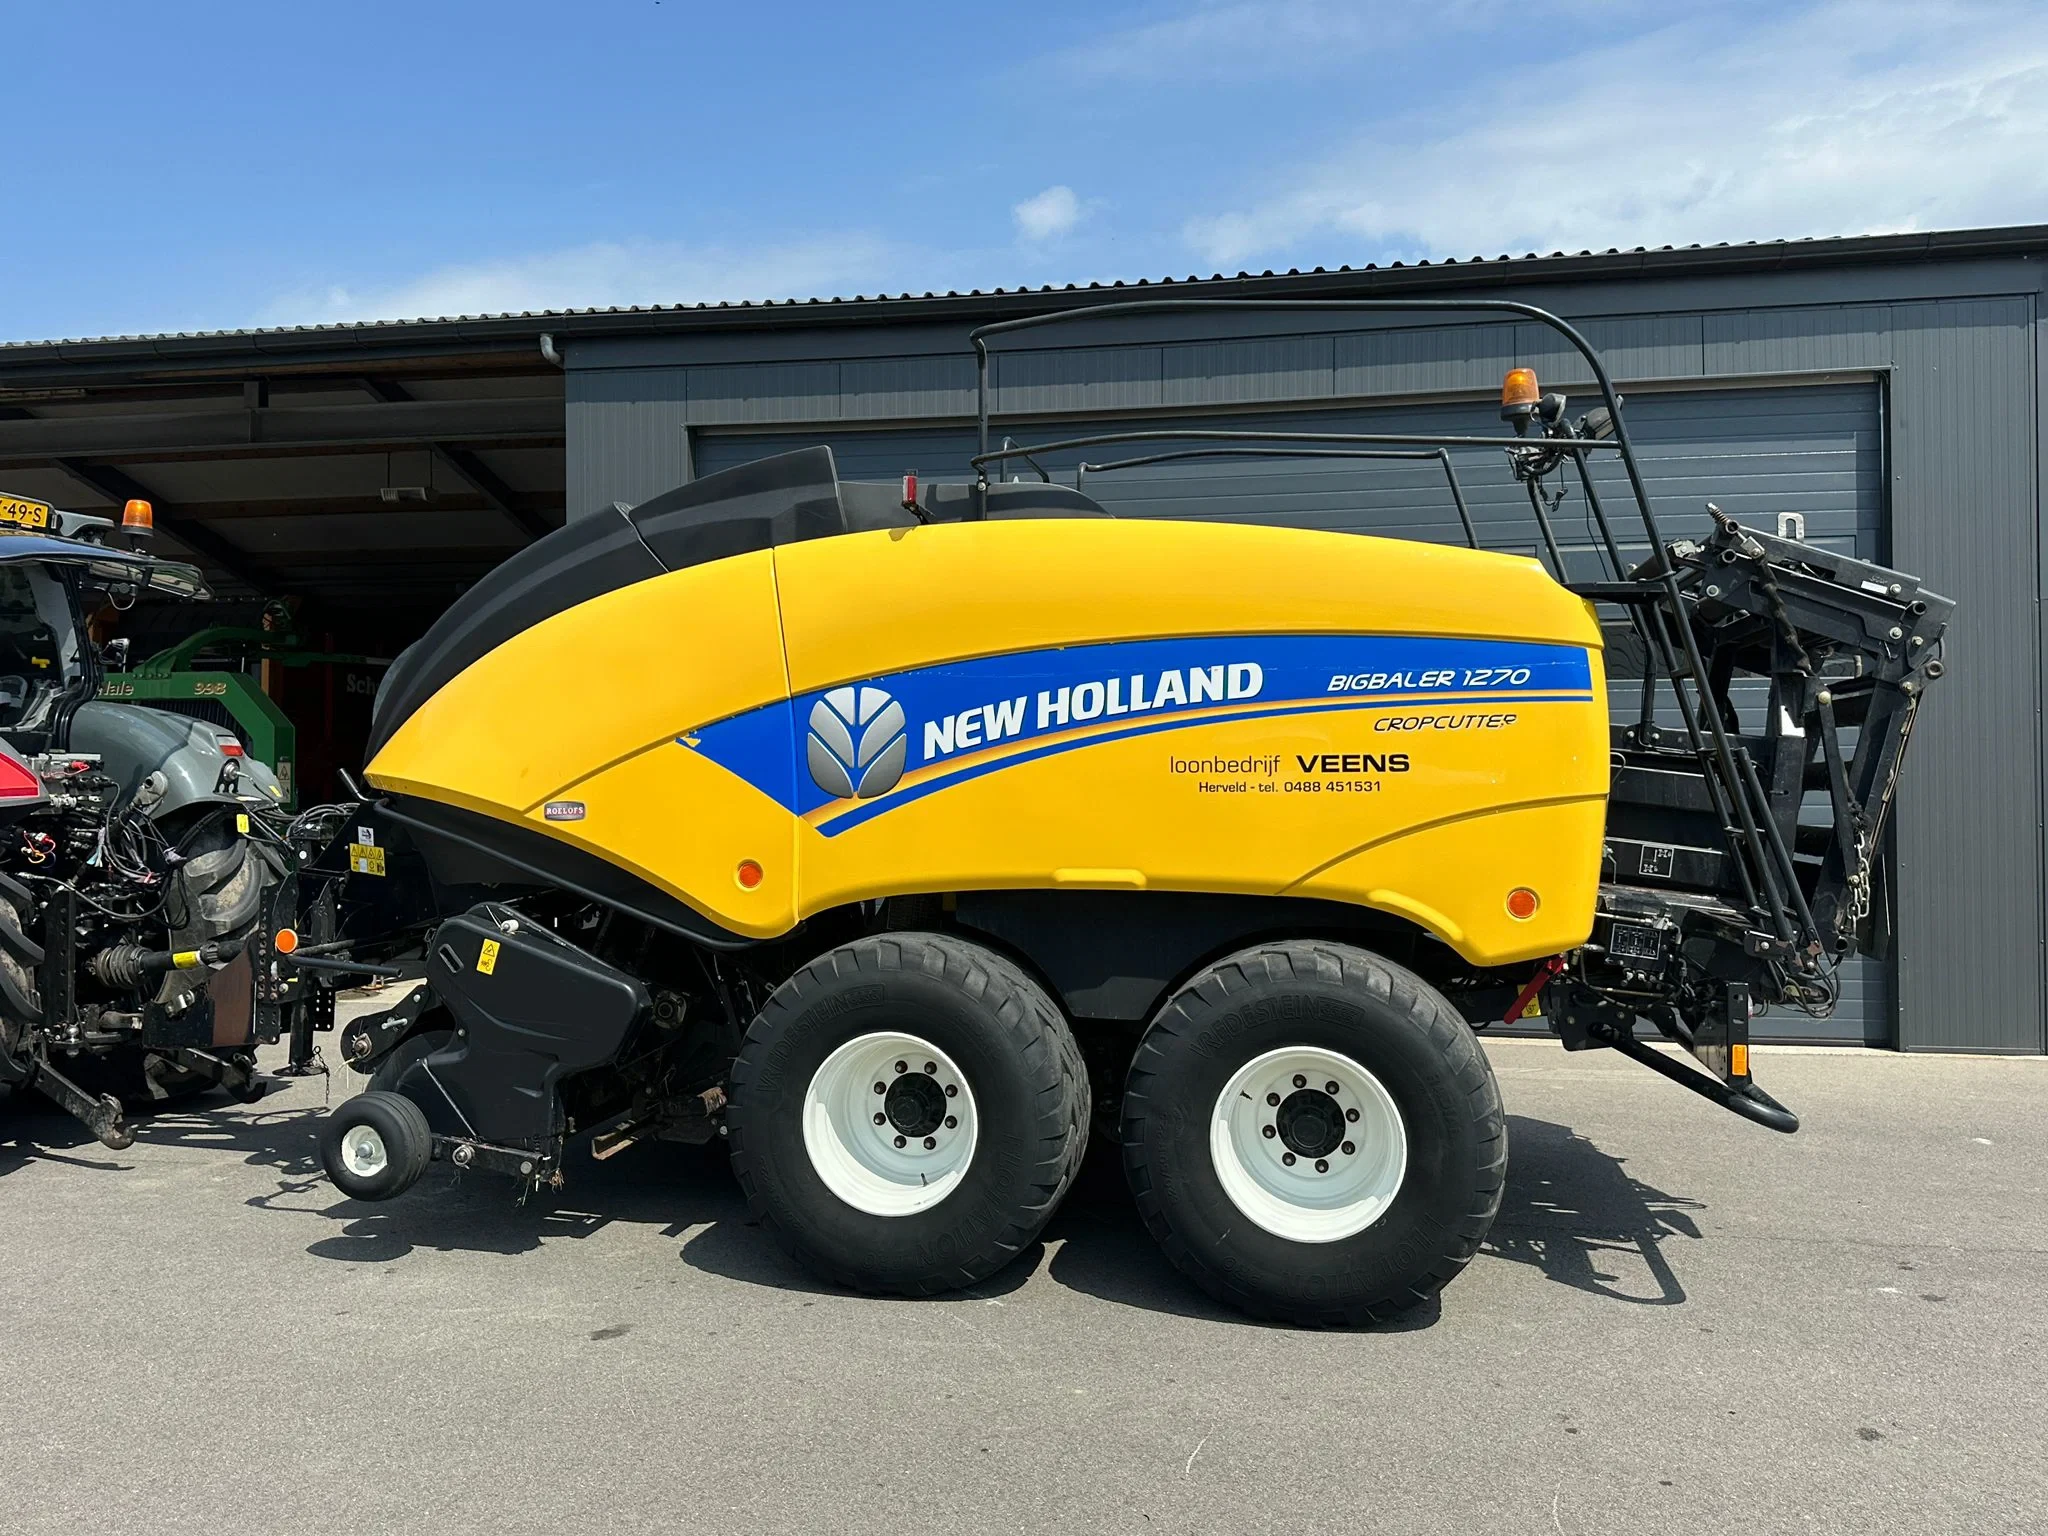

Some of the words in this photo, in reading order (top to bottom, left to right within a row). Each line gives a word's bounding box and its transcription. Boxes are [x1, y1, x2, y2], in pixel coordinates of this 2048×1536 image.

[0, 500, 42, 523] -49-S
[346, 673, 376, 695] Sch
[1327, 670, 1457, 693] BIGBALER
[1462, 668, 1531, 688] 1270
[923, 694, 1029, 761] NEW
[1036, 662, 1264, 729] HOLLAND
[1374, 714, 1517, 731] CROPCUTTER
[1169, 755, 1280, 777] loonbedrijf
[1296, 754, 1410, 773] VEENS
[1199, 781, 1247, 793] Herveld
[1258, 781, 1279, 793] tel.
[1284, 781, 1321, 793] 0488
[1326, 781, 1381, 793] 451531
[546, 807, 584, 815] ROELOFS
